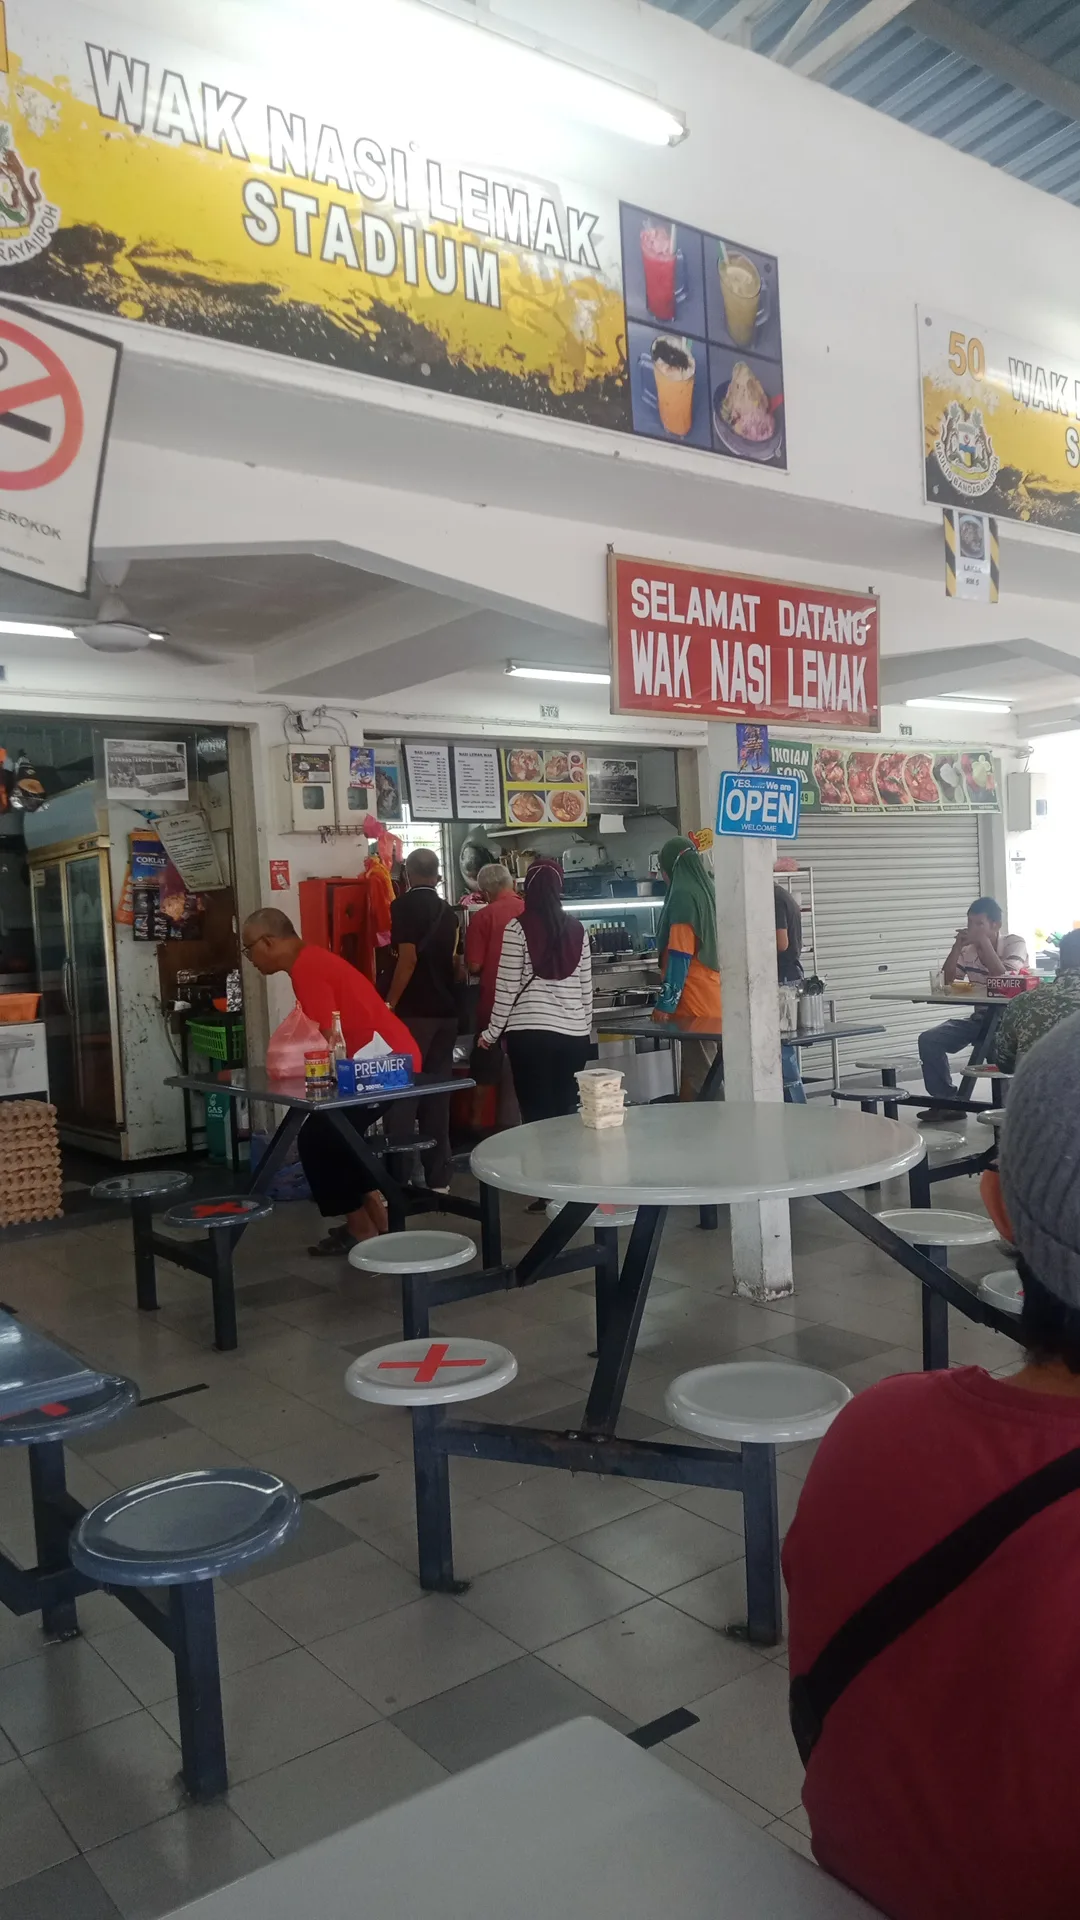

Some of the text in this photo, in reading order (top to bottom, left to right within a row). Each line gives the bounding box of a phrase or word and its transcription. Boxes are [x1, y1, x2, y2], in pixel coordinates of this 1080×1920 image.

[85, 43, 602, 269] WAK NASI LEMAK
[242, 178, 502, 309] STADIUM
[948, 330, 985, 382] 50
[1008, 356, 1069, 417] WAK
[631, 578, 867, 646] SELAMAT DATANG
[630, 629, 867, 713] WAK NASI LEMAK
[771, 747, 809, 766] INDIAN
[780, 784, 792, 792] are
[726, 788, 795, 824] OPEN
[741, 823, 777, 832] WELCOME
[136, 856, 166, 865] COKLAT
[988, 978, 1020, 988] PREMIER
[354, 1058, 405, 1077] PREMIER
[207, 1106, 223, 1114] GAS
